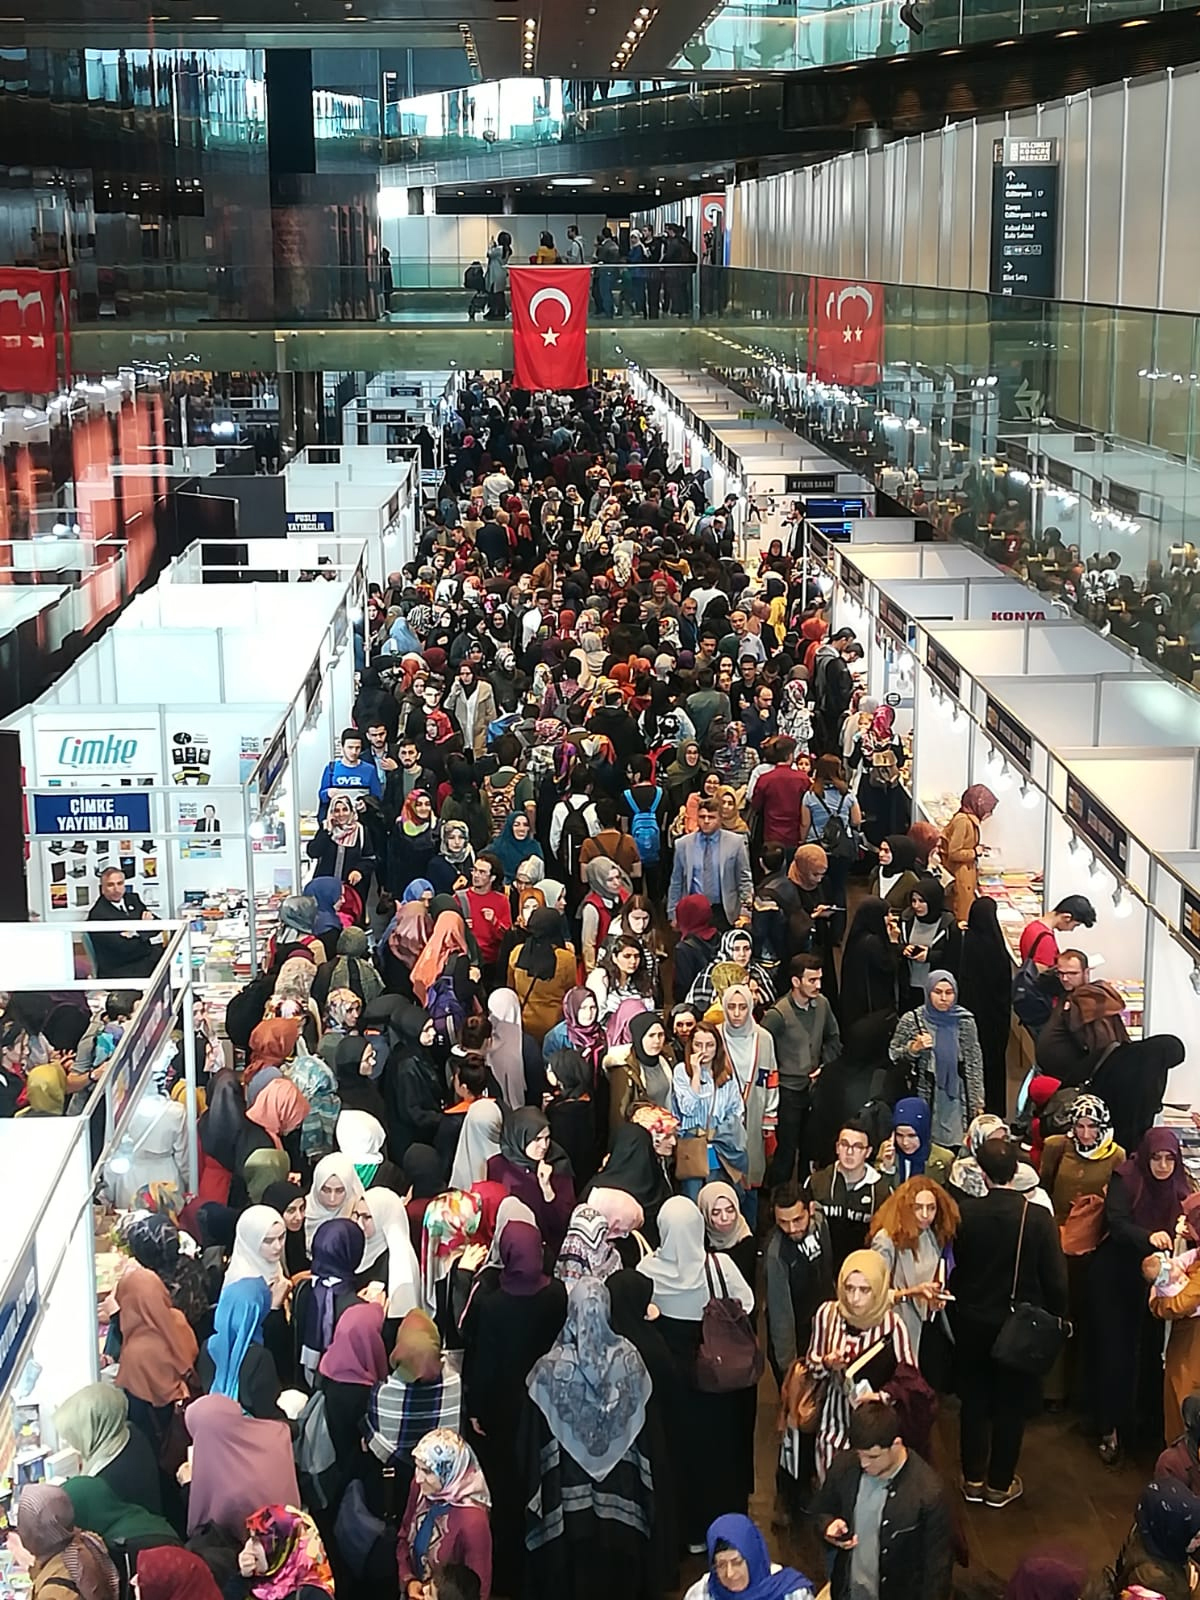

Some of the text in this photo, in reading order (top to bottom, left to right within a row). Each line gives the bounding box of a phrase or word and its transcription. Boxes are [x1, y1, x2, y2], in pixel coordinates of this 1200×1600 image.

[991, 611, 1046, 621] KONYA
[70, 797, 115, 815] ÇİMKE
[56, 815, 129, 831] YAYINLARI
